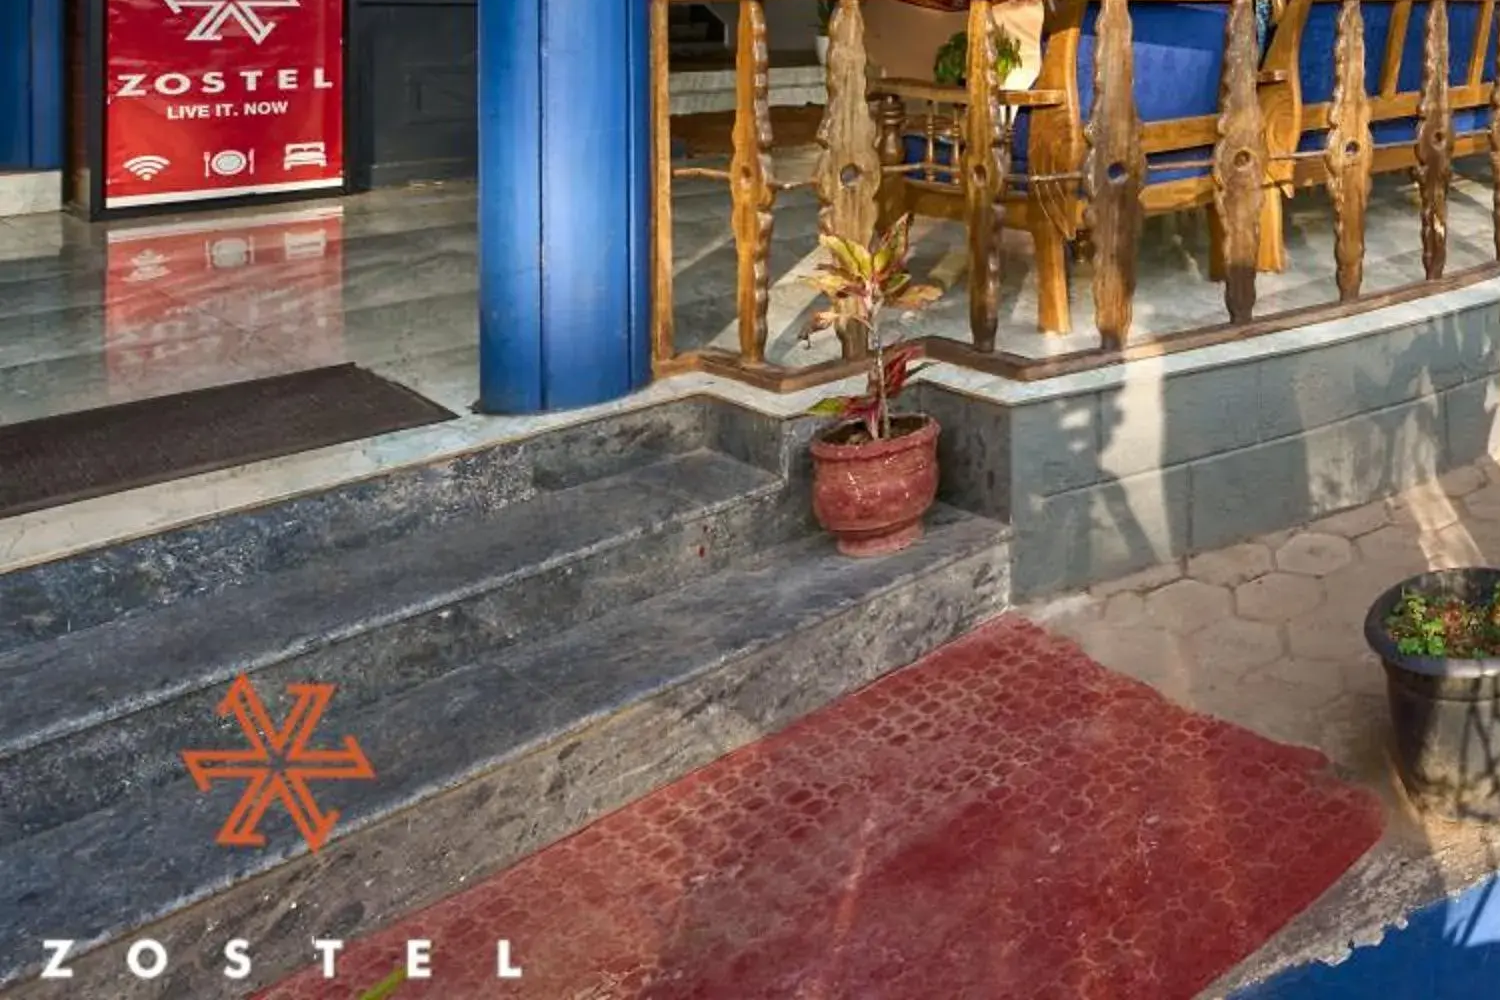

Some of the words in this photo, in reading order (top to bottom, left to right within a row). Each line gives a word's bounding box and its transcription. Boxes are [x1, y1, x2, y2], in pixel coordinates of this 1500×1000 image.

[115, 67, 334, 97] ZOSTEL
[166, 104, 210, 120] LIVE
[215, 103, 239, 118] IT.
[244, 101, 289, 116] NOW
